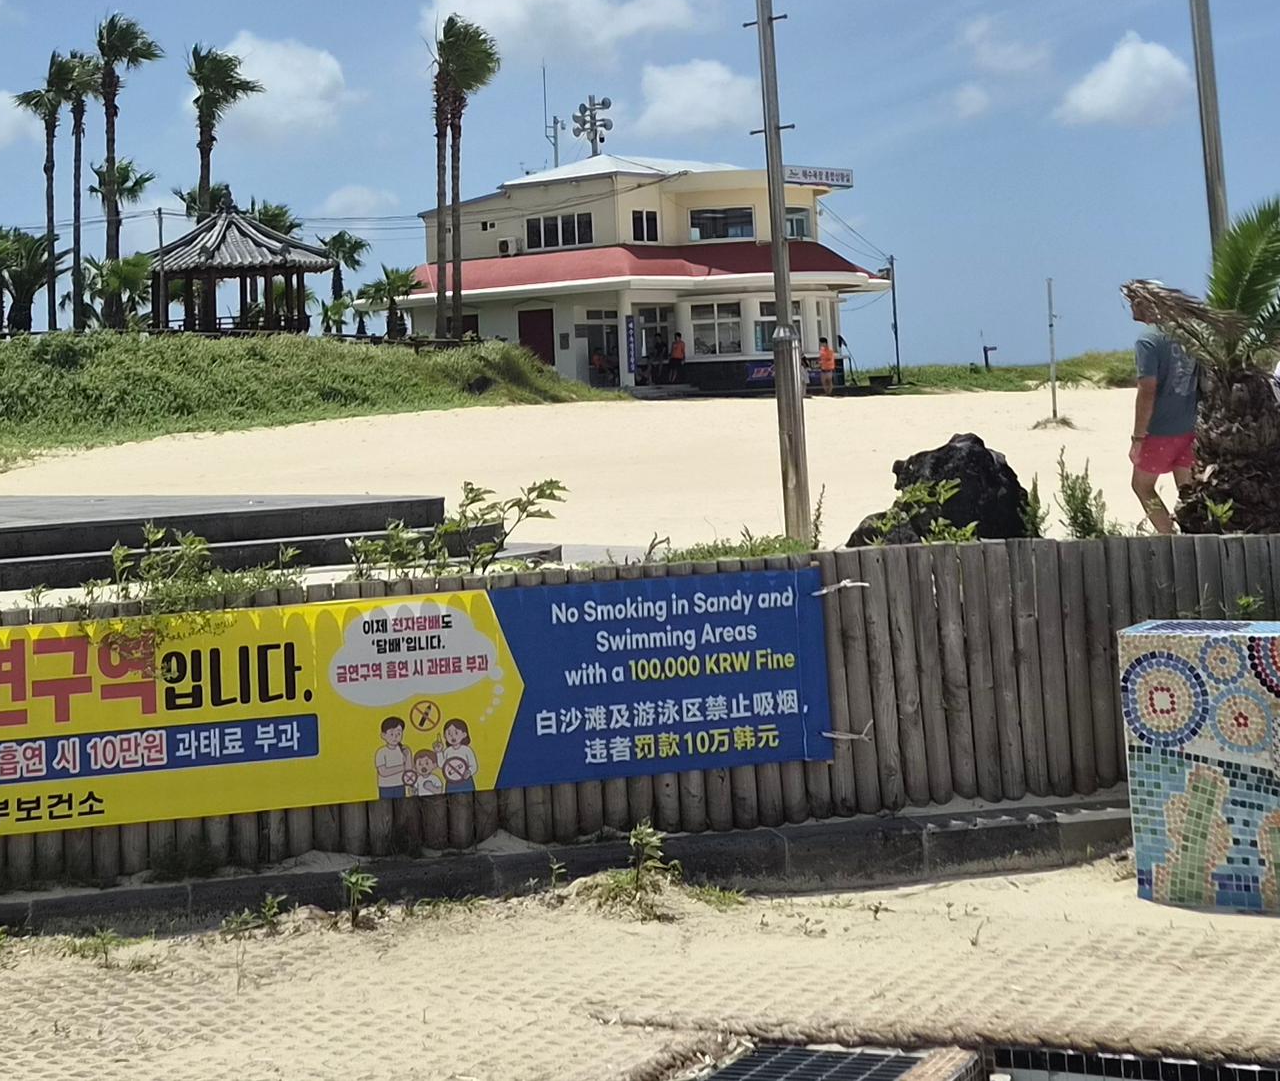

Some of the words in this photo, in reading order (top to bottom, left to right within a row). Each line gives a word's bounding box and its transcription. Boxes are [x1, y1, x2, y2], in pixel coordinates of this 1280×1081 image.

[551, 603, 579, 624] No
[583, 596, 667, 622] Smoking
[671, 594, 689, 616] in
[693, 589, 753, 615] Sandy
[757, 586, 794, 609] and
[362, 619, 388, 635] 이제
[392, 614, 453, 633] 전자담배도
[596, 626, 696, 653] Swimming
[701, 623, 758, 644] Areas
[336, 662, 383, 684] 금연구역
[386, 660, 409, 680] 흡연
[412, 659, 424, 677] 시
[427, 656, 463, 676] 과태료
[466, 654, 489, 673] 부과
[564, 663, 607, 687] with
[611, 666, 625, 683] a
[628, 655, 701, 681] 100,000
[705, 651, 750, 675] KRW
[755, 648, 796, 670] Fine
[53, 737, 80, 774] 시
[87, 729, 168, 769] 10만원
[175, 727, 245, 760] 과태료
[254, 721, 301, 753] 부과
